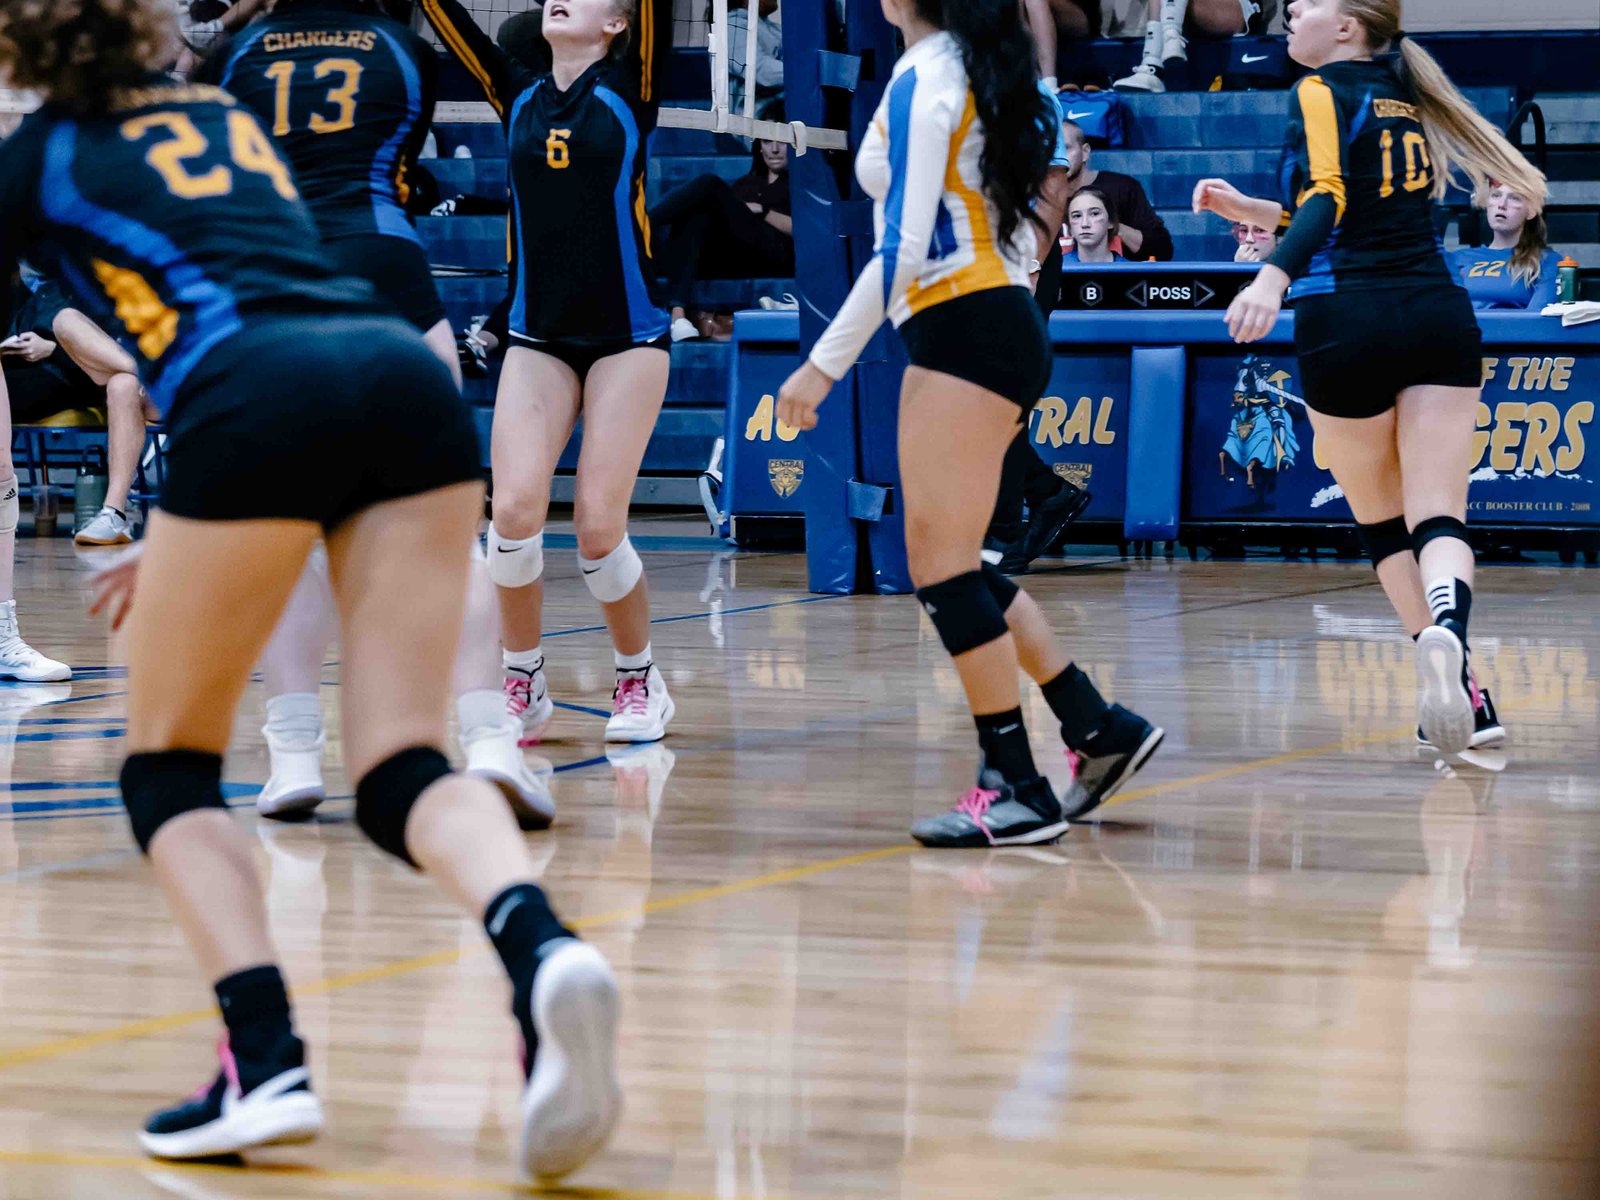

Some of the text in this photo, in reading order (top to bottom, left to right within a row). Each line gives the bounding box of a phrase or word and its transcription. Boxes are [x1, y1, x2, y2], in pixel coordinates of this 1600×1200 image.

[264, 58, 365, 136] 13
[119, 111, 299, 200] 24
[546, 128, 572, 169] 6
[1379, 129, 1431, 198] 10
[1468, 260, 1506, 278] 22
[1086, 287, 1097, 300] B
[1150, 286, 1191, 300] POSS
[1507, 357, 1575, 391] THE
[1028, 396, 1116, 449] RAL
[1485, 502, 1534, 511] BOOSTER
[1535, 502, 1563, 511] CLUB
